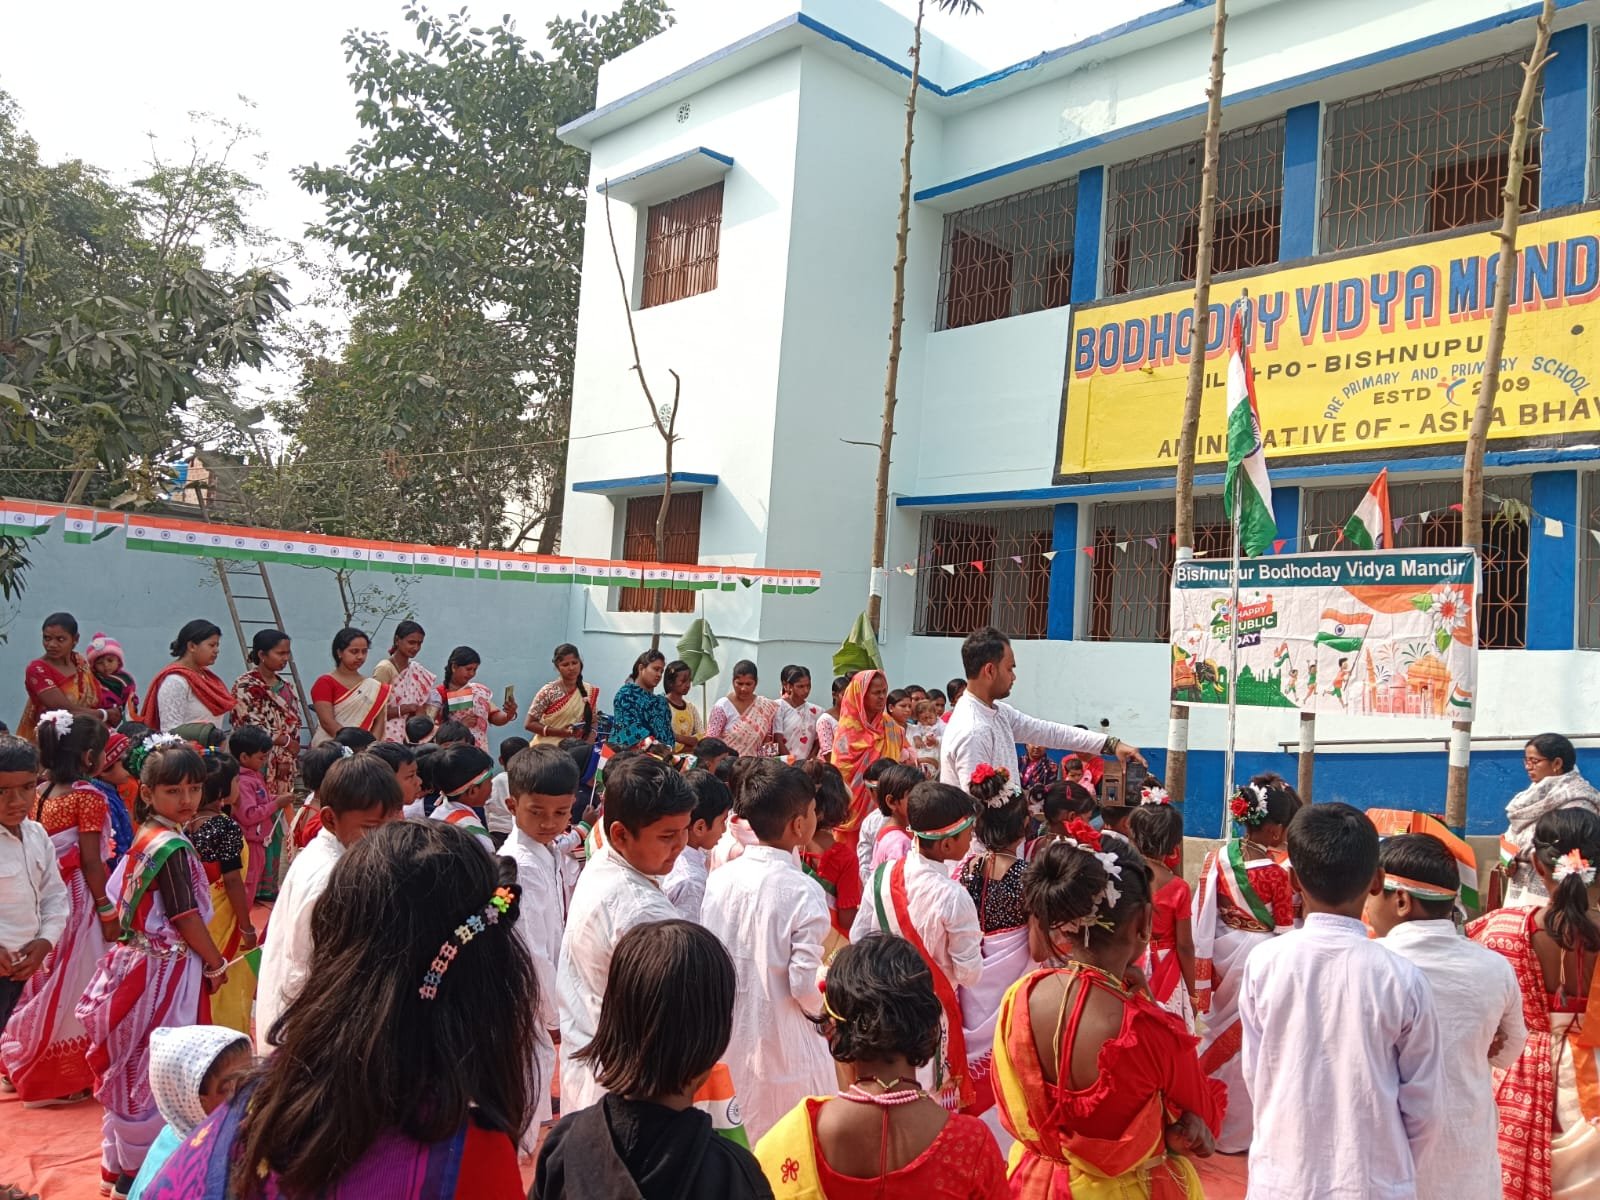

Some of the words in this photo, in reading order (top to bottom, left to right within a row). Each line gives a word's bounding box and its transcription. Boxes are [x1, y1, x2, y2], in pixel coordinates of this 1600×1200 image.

[1296, 264, 1440, 345] VIDYA
[1323, 396, 1345, 420] PRE
[1342, 371, 1400, 399] PRIMARY
[1411, 367, 1439, 381] AND
[1451, 357, 1519, 377] PRIMRY
[1531, 356, 1591, 396] SCHOOL
[1373, 387, 1432, 405] ESTD
[1471, 376, 1530, 395] 209
[1355, 418, 1392, 440] OF
[1259, 562, 1341, 582] Bodhoday
[1345, 560, 1396, 581] Vidya
[1401, 559, 1466, 577] Mandir
[1216, 615, 1274, 637] REUBLIC
